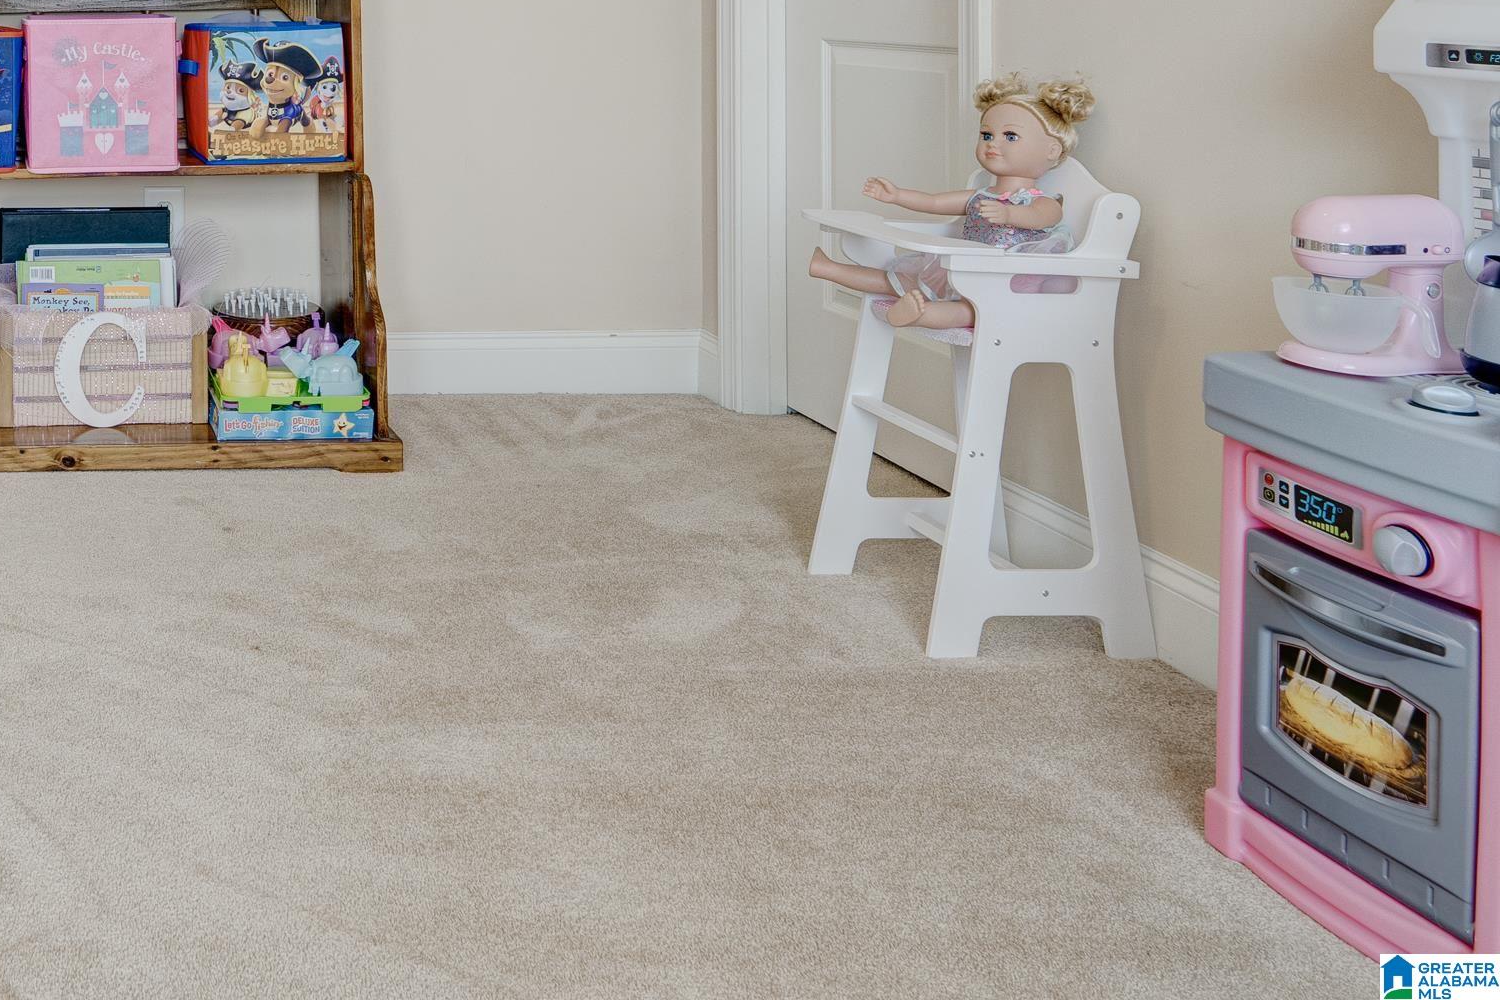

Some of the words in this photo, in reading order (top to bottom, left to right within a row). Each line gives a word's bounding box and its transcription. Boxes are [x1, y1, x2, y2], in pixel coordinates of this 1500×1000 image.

[63, 45, 88, 62] My
[93, 41, 142, 60] Castle
[210, 133, 288, 156] Treasure
[289, 129, 339, 156] Hunt!
[32, 296, 70, 306] Monkey
[72, 296, 91, 306] See,
[53, 311, 148, 428] C
[224, 418, 241, 432] Let's
[241, 420, 252, 430] Go
[292, 417, 320, 426] DELUXE
[292, 425, 321, 434] EDITION
